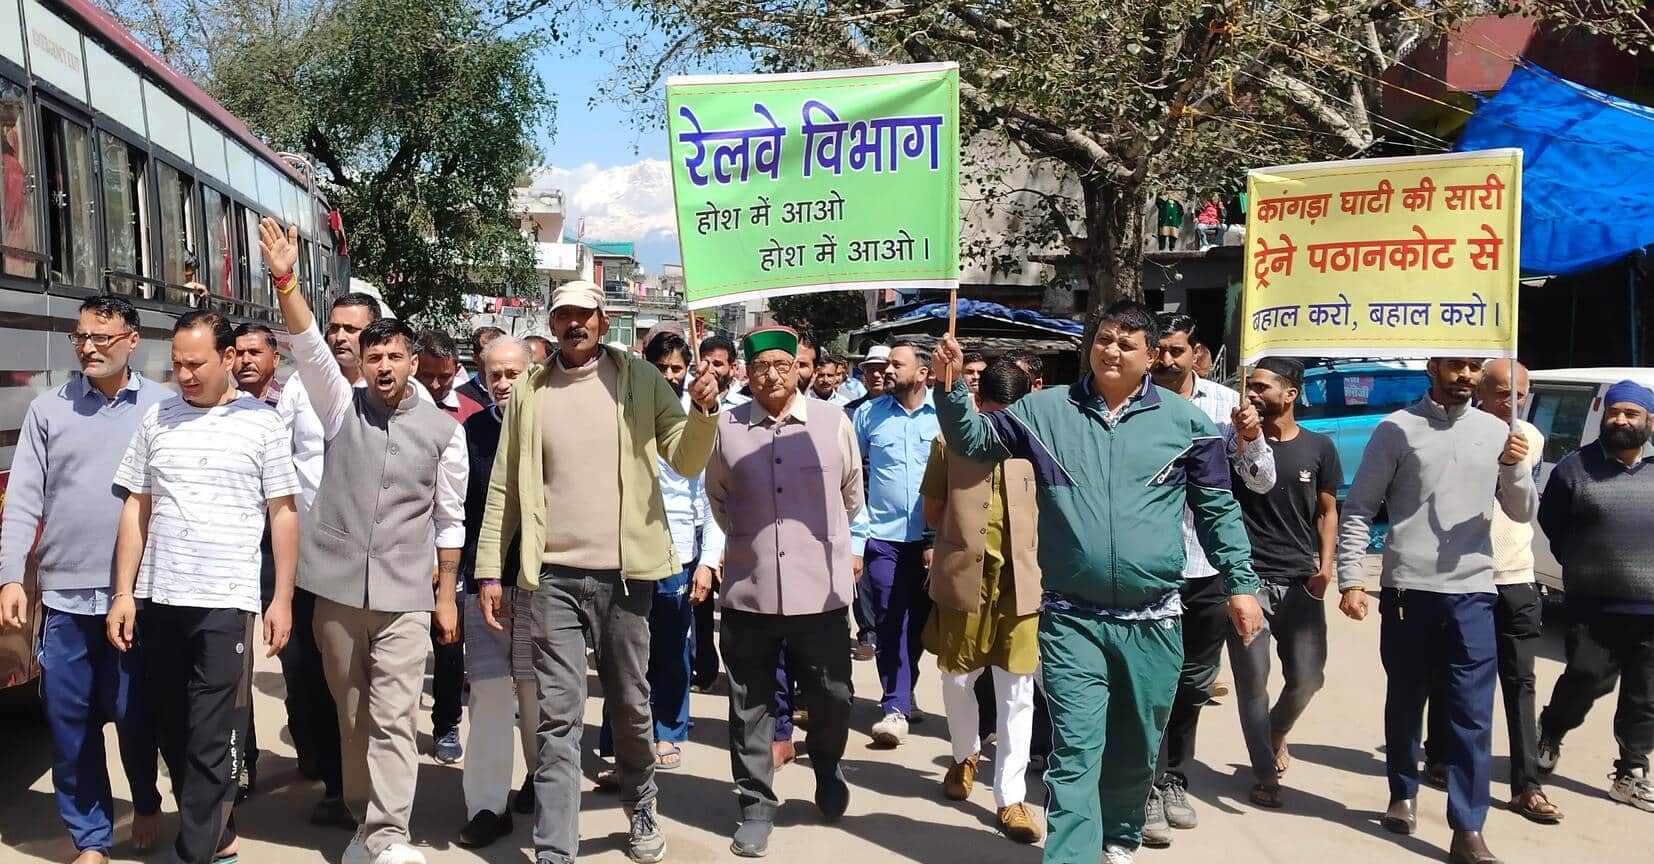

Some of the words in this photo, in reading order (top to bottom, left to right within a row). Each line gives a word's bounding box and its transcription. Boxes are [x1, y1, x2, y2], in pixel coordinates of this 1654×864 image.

[680, 104, 785, 185] रेलवे
[801, 101, 942, 176] विभाग
[696, 202, 741, 234] होश
[750, 196, 771, 225] में
[782, 191, 845, 223] आओ
[1258, 190, 1331, 225] कांगड़ा
[1340, 180, 1394, 214] घाटी
[1403, 177, 1436, 211] की
[1445, 174, 1504, 210] सारी
[760, 239, 805, 271] होश
[814, 235, 837, 263] में
[848, 230, 914, 261] आओ
[1307, 225, 1456, 272] पठानकोट
[1468, 224, 1502, 270] से
[1253, 306, 1300, 331] बहाल
[1369, 303, 1431, 327] बहाल
